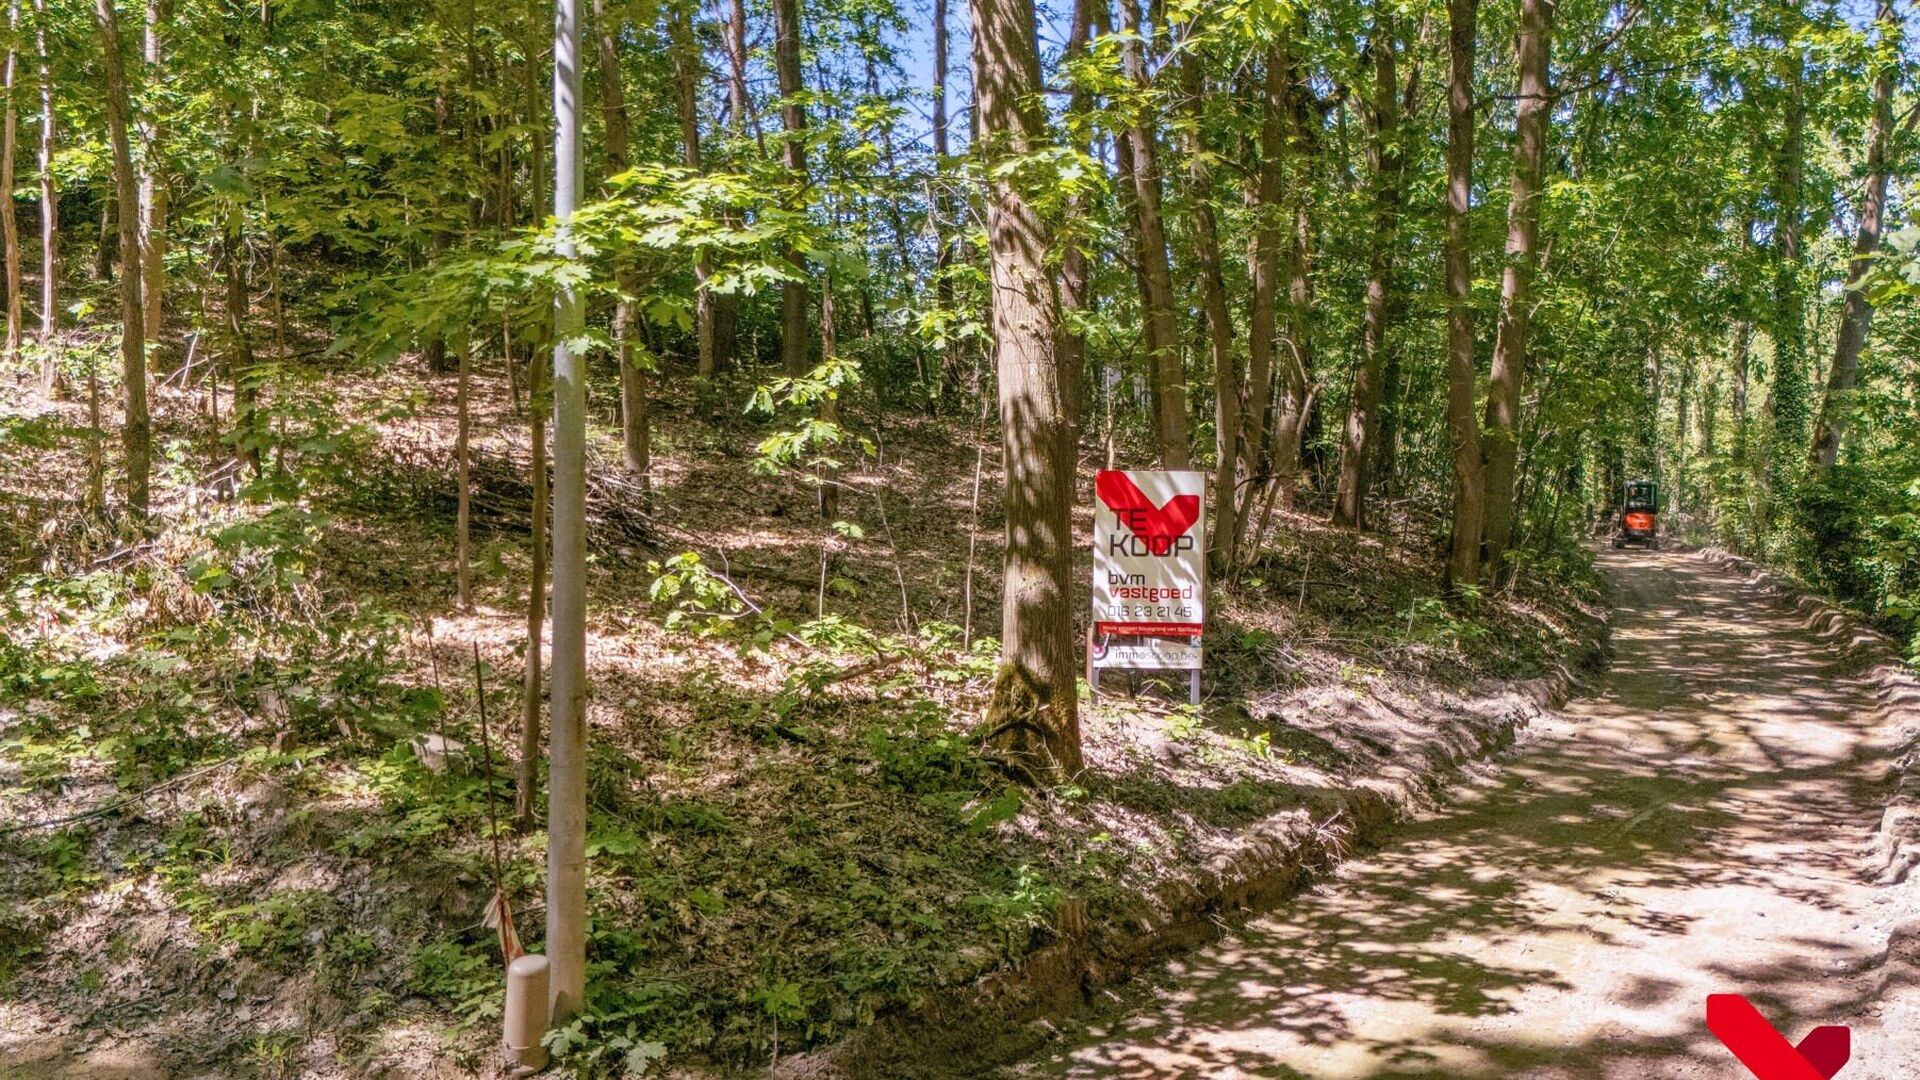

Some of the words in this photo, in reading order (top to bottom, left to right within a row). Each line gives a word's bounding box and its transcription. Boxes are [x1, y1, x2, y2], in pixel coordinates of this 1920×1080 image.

[1110, 508, 1147, 531] TE
[1110, 534, 1193, 557] KOOP
[1108, 571, 1145, 585] bvm
[1109, 585, 1192, 602] vastgoed
[1108, 605, 1129, 617] 016
[1134, 605, 1152, 617] 23
[1157, 606, 1170, 618] 21
[1174, 606, 1192, 618] 45
